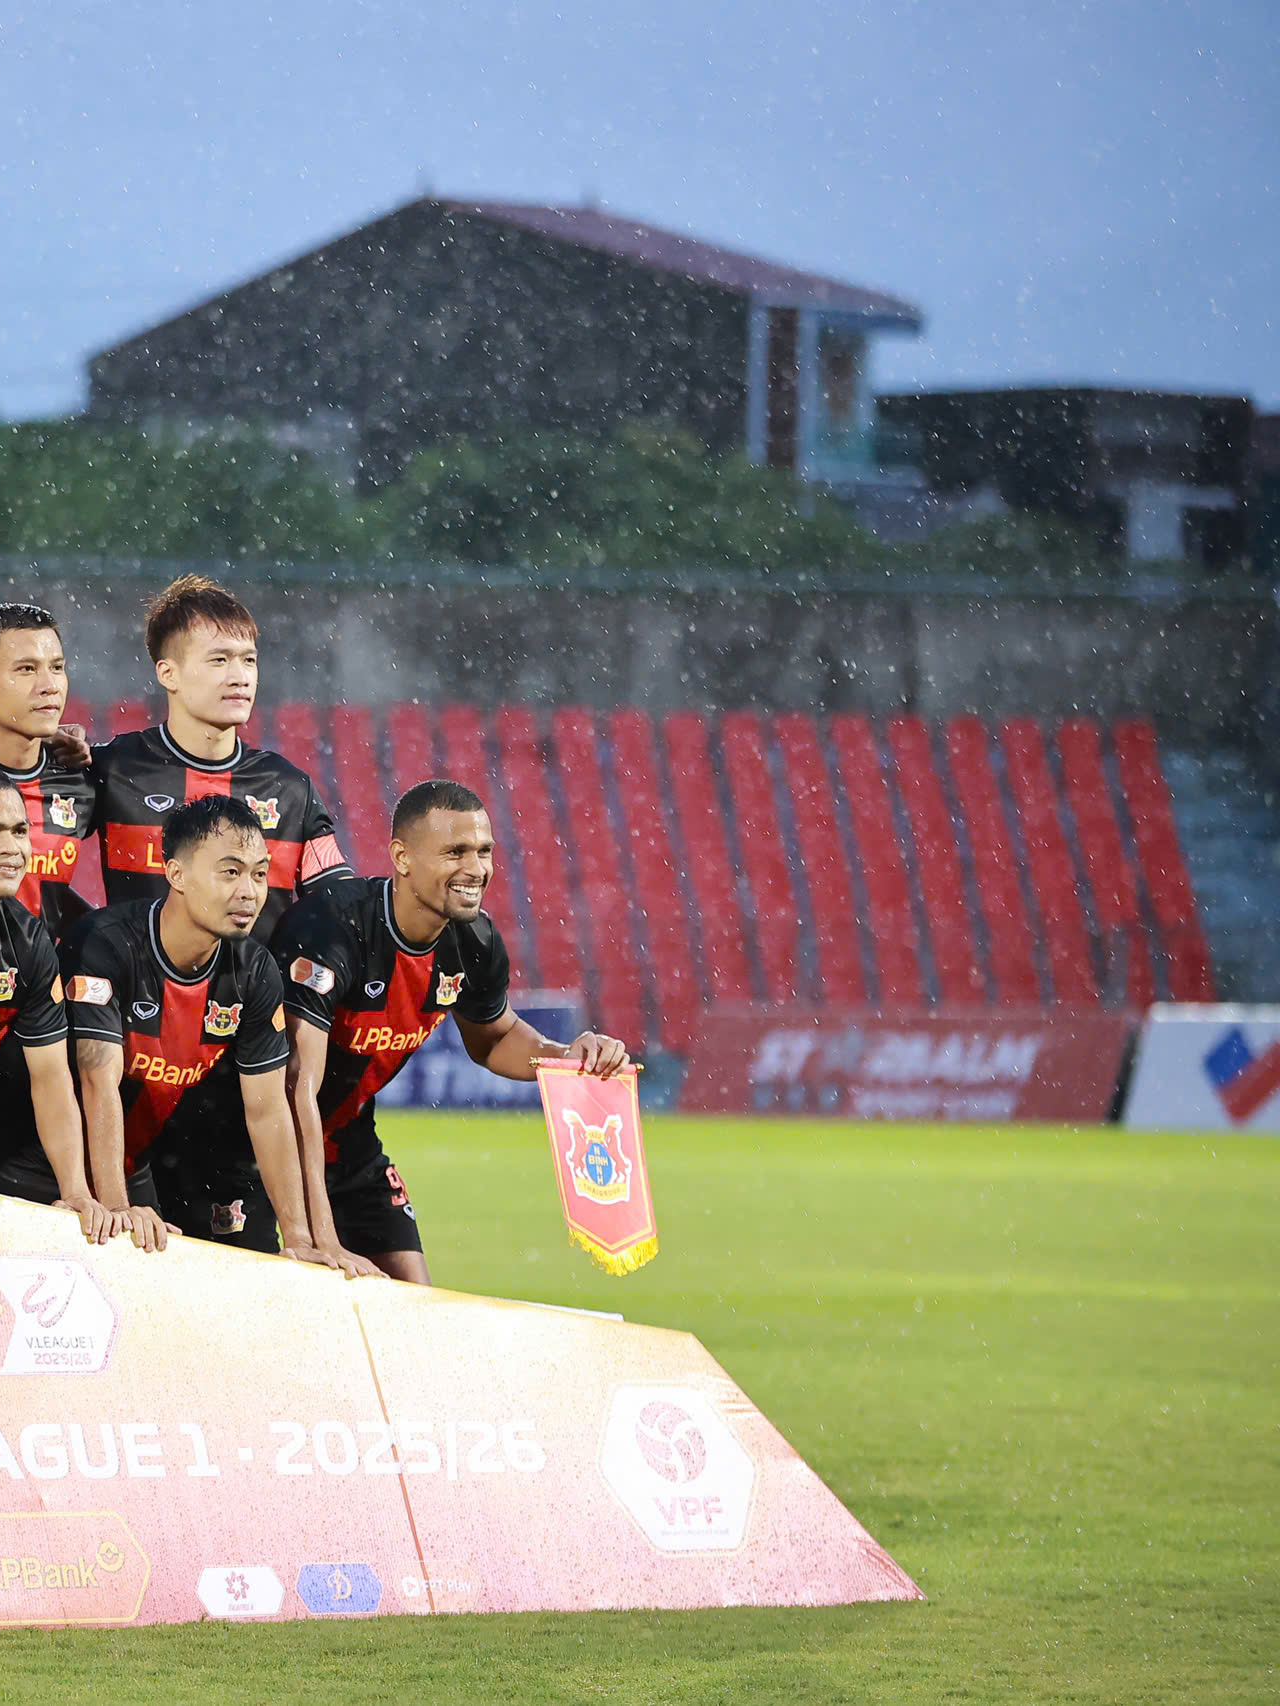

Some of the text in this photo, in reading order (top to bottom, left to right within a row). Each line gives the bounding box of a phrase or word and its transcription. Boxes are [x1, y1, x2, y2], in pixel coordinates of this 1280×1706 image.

[349, 1025, 430, 1051] LPBank
[128, 1052, 209, 1086] PBank
[179, 1423, 220, 1476] 1
[652, 1496, 724, 1525] VPF
